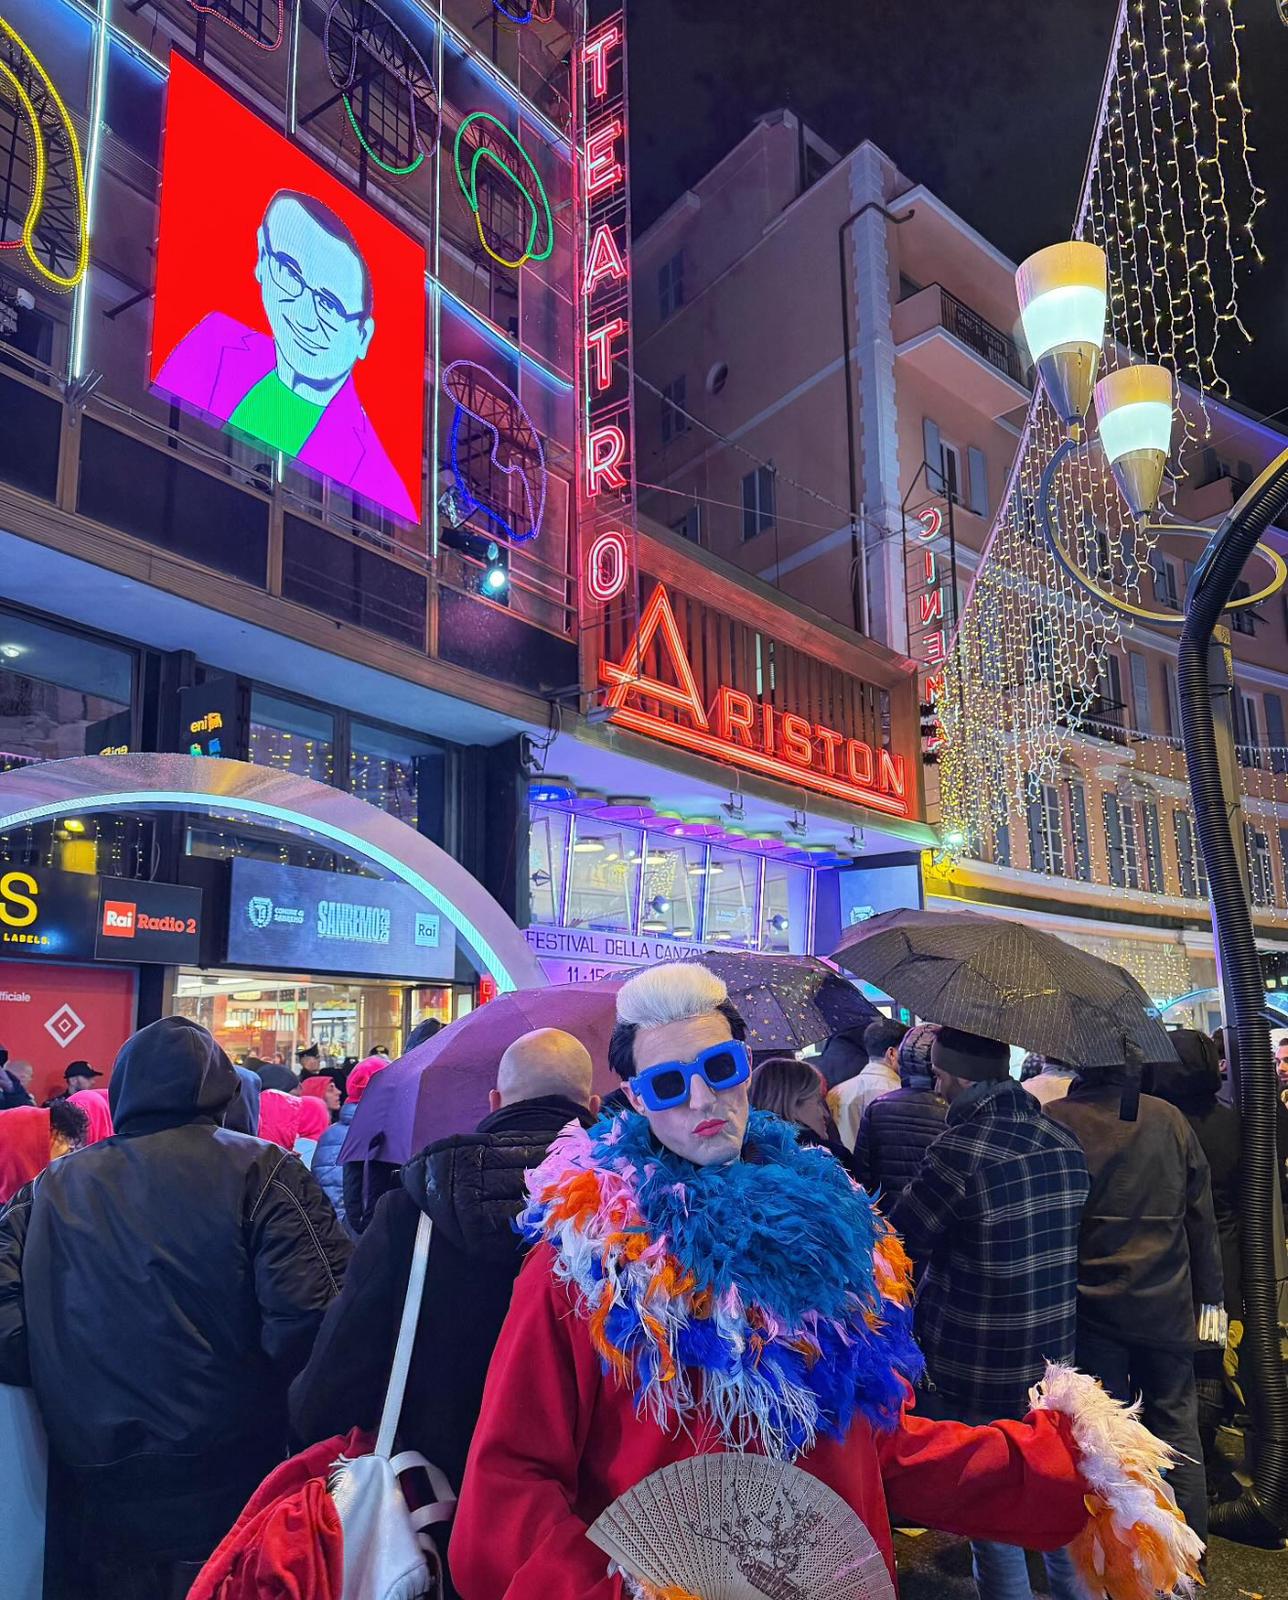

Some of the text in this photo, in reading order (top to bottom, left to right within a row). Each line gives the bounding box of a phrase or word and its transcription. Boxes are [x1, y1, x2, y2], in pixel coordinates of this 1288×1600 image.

[581, 26, 629, 603] TEATRO
[599, 581, 906, 797] ARISTON
[106, 910, 196, 934] Rai Radio 2
[317, 900, 380, 940] SANREMO
[418, 923, 436, 937] Rai
[526, 930, 599, 953] FESTIVAL
[605, 938, 650, 959] DELLA
